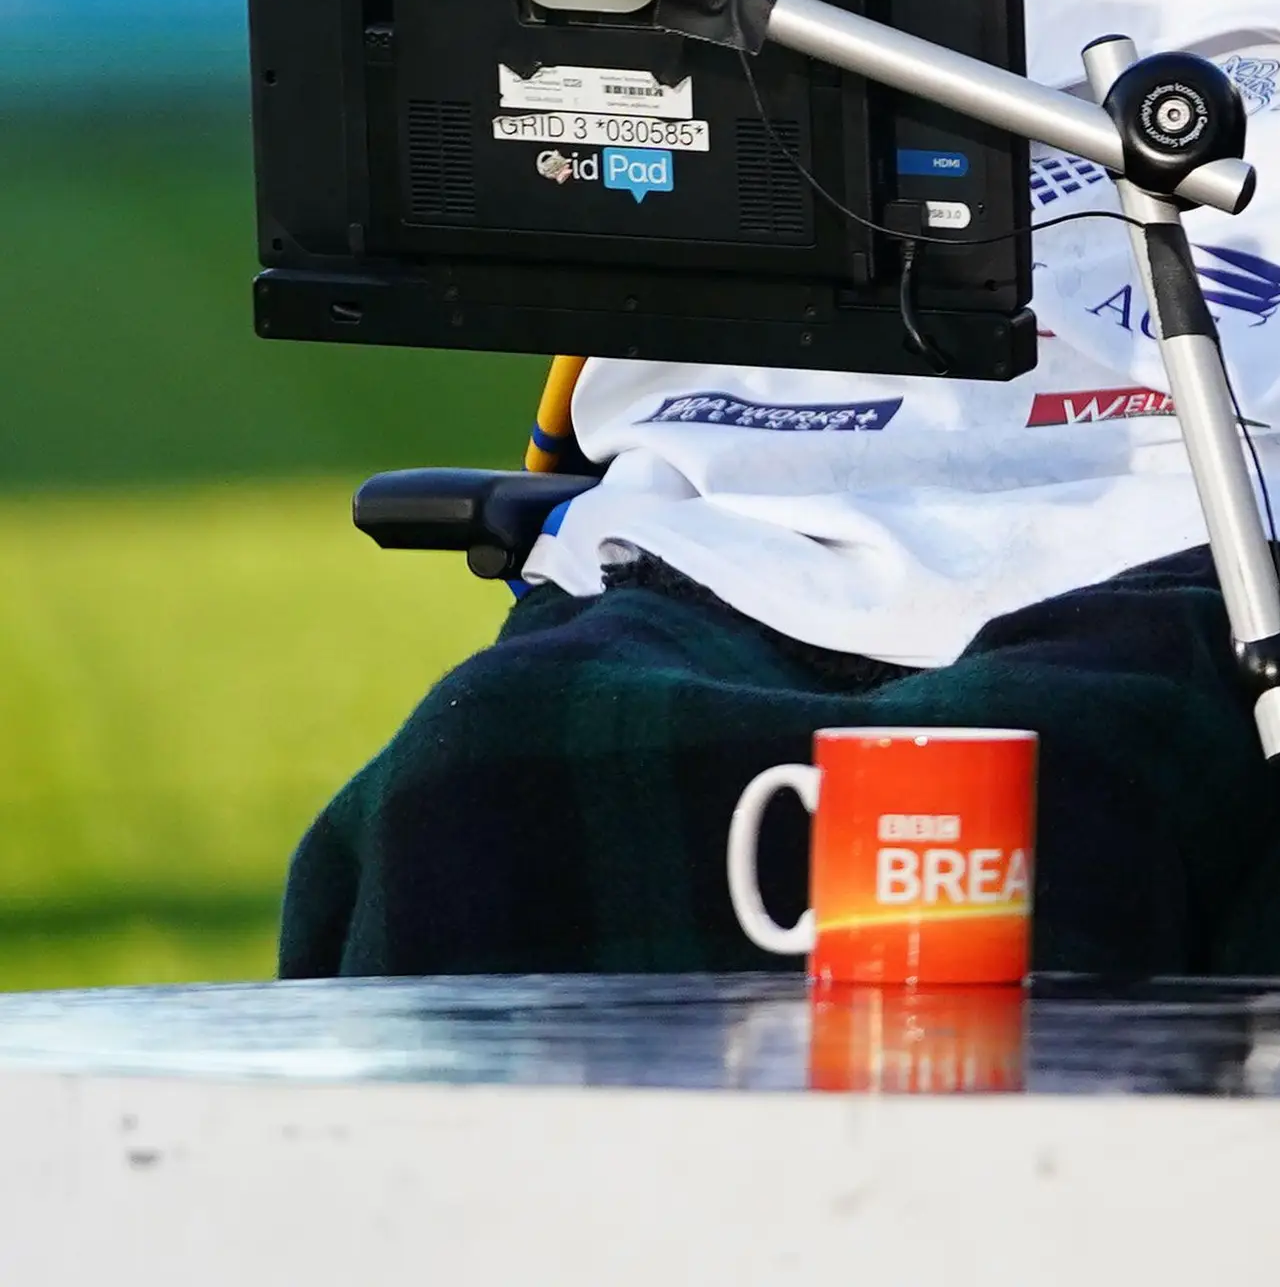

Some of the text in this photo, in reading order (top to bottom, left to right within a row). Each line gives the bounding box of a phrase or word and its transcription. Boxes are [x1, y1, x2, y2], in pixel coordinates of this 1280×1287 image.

[500, 115, 565, 137] GRID
[573, 117, 588, 140] 3
[609, 154, 668, 184] Pad
[933, 158, 961, 168] HDMI
